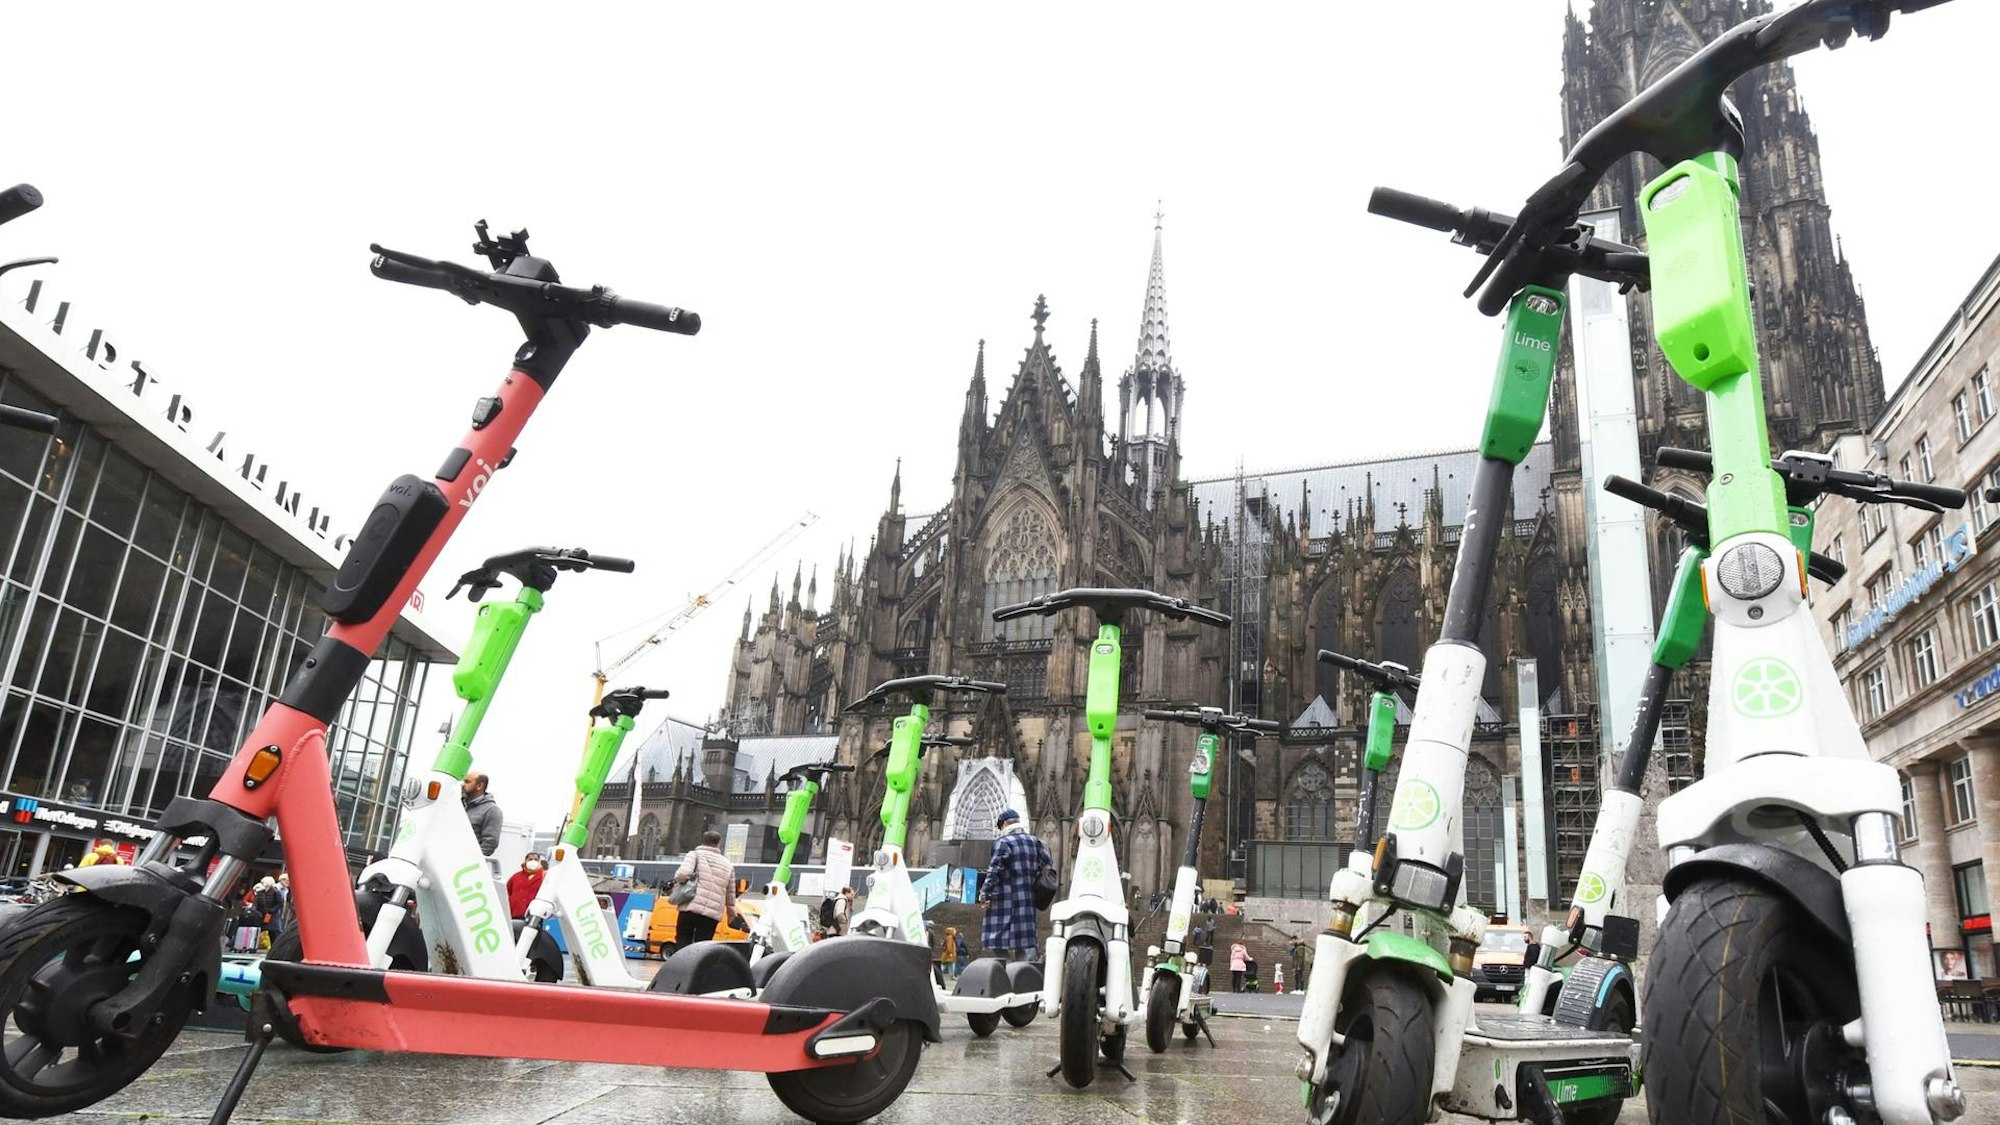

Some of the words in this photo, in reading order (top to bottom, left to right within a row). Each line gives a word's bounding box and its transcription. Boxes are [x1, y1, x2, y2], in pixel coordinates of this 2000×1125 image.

[1514, 331, 1551, 351] Lime
[453, 863, 500, 955] Lime
[575, 901, 609, 960] Lime
[1556, 1079, 1577, 1103] Lime
